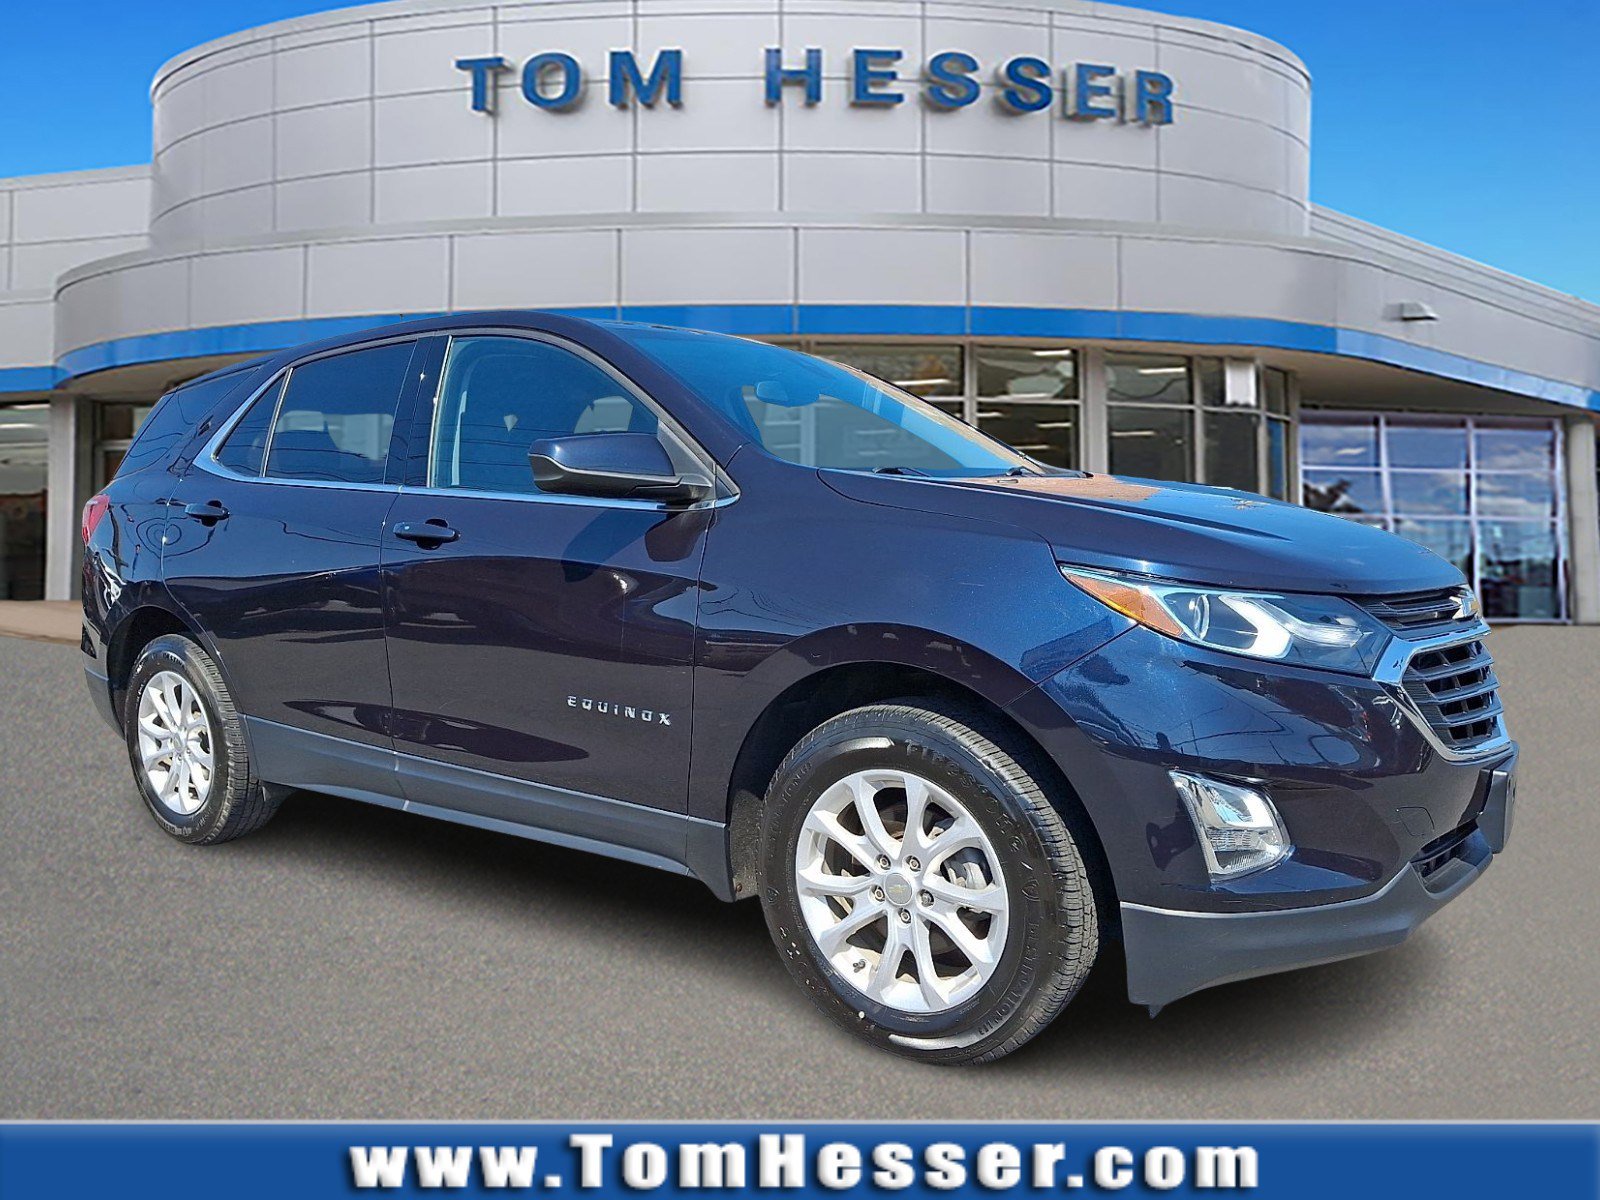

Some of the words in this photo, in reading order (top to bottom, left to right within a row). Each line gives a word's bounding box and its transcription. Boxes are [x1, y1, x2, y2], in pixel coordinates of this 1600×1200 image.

[455, 48, 684, 112] TOM
[763, 48, 1175, 126] HESSER
[566, 695, 672, 727] EQUINOX
